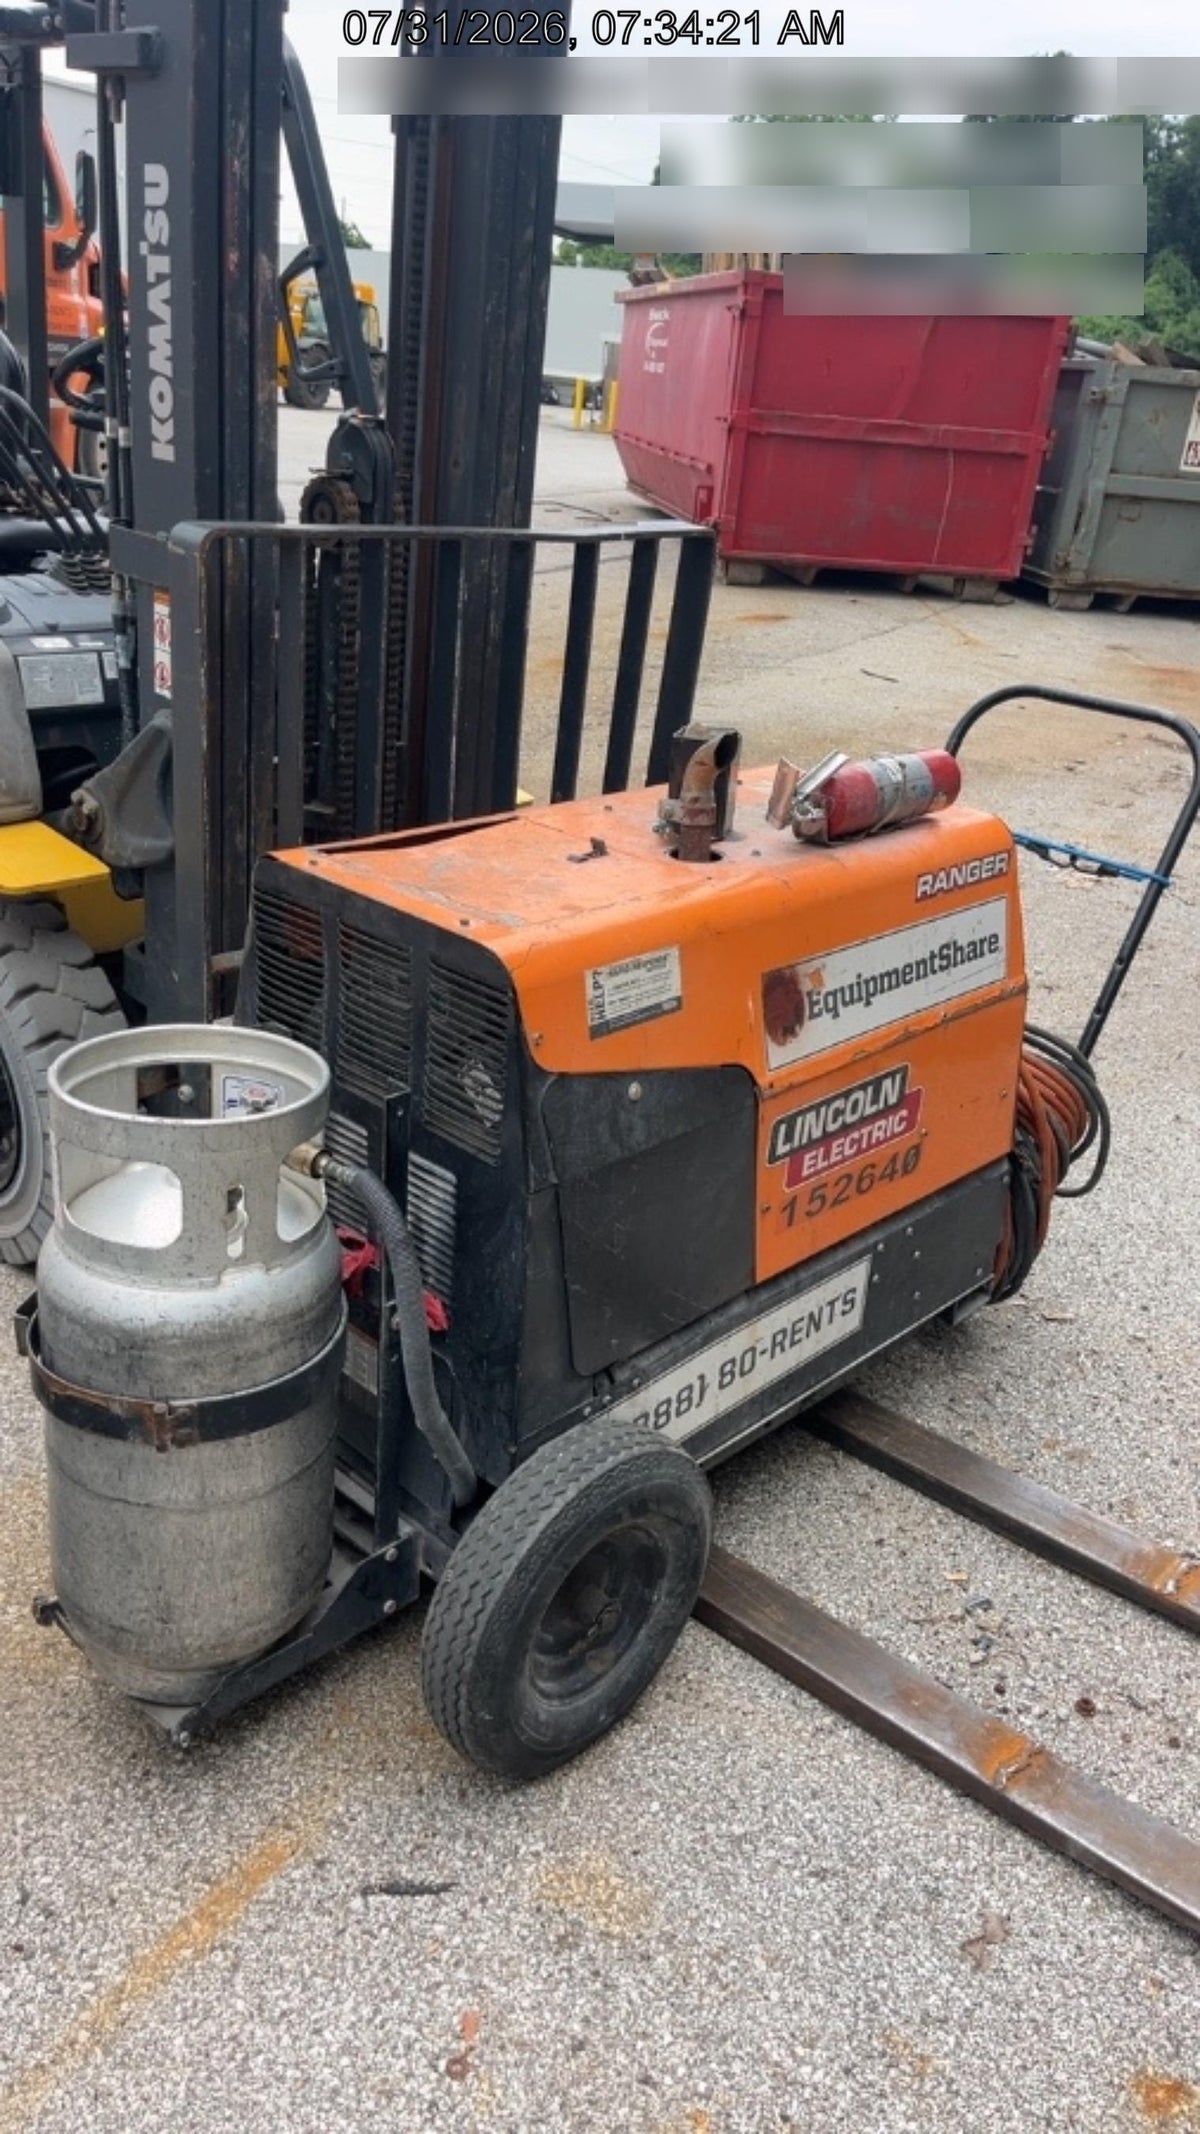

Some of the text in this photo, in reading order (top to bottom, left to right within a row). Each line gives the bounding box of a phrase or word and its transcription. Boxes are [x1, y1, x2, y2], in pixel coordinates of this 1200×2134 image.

[139, 163, 175, 462] KOMATSU
[916, 853, 1009, 899] RANGER
[807, 932, 1000, 1021] EquipmentShare
[775, 1073, 903, 1157] LINCOLN
[801, 1109, 909, 1177] ELECTRIC
[781, 1142, 923, 1228] 152640
[718, 1286, 857, 1391] 80-RENTS
